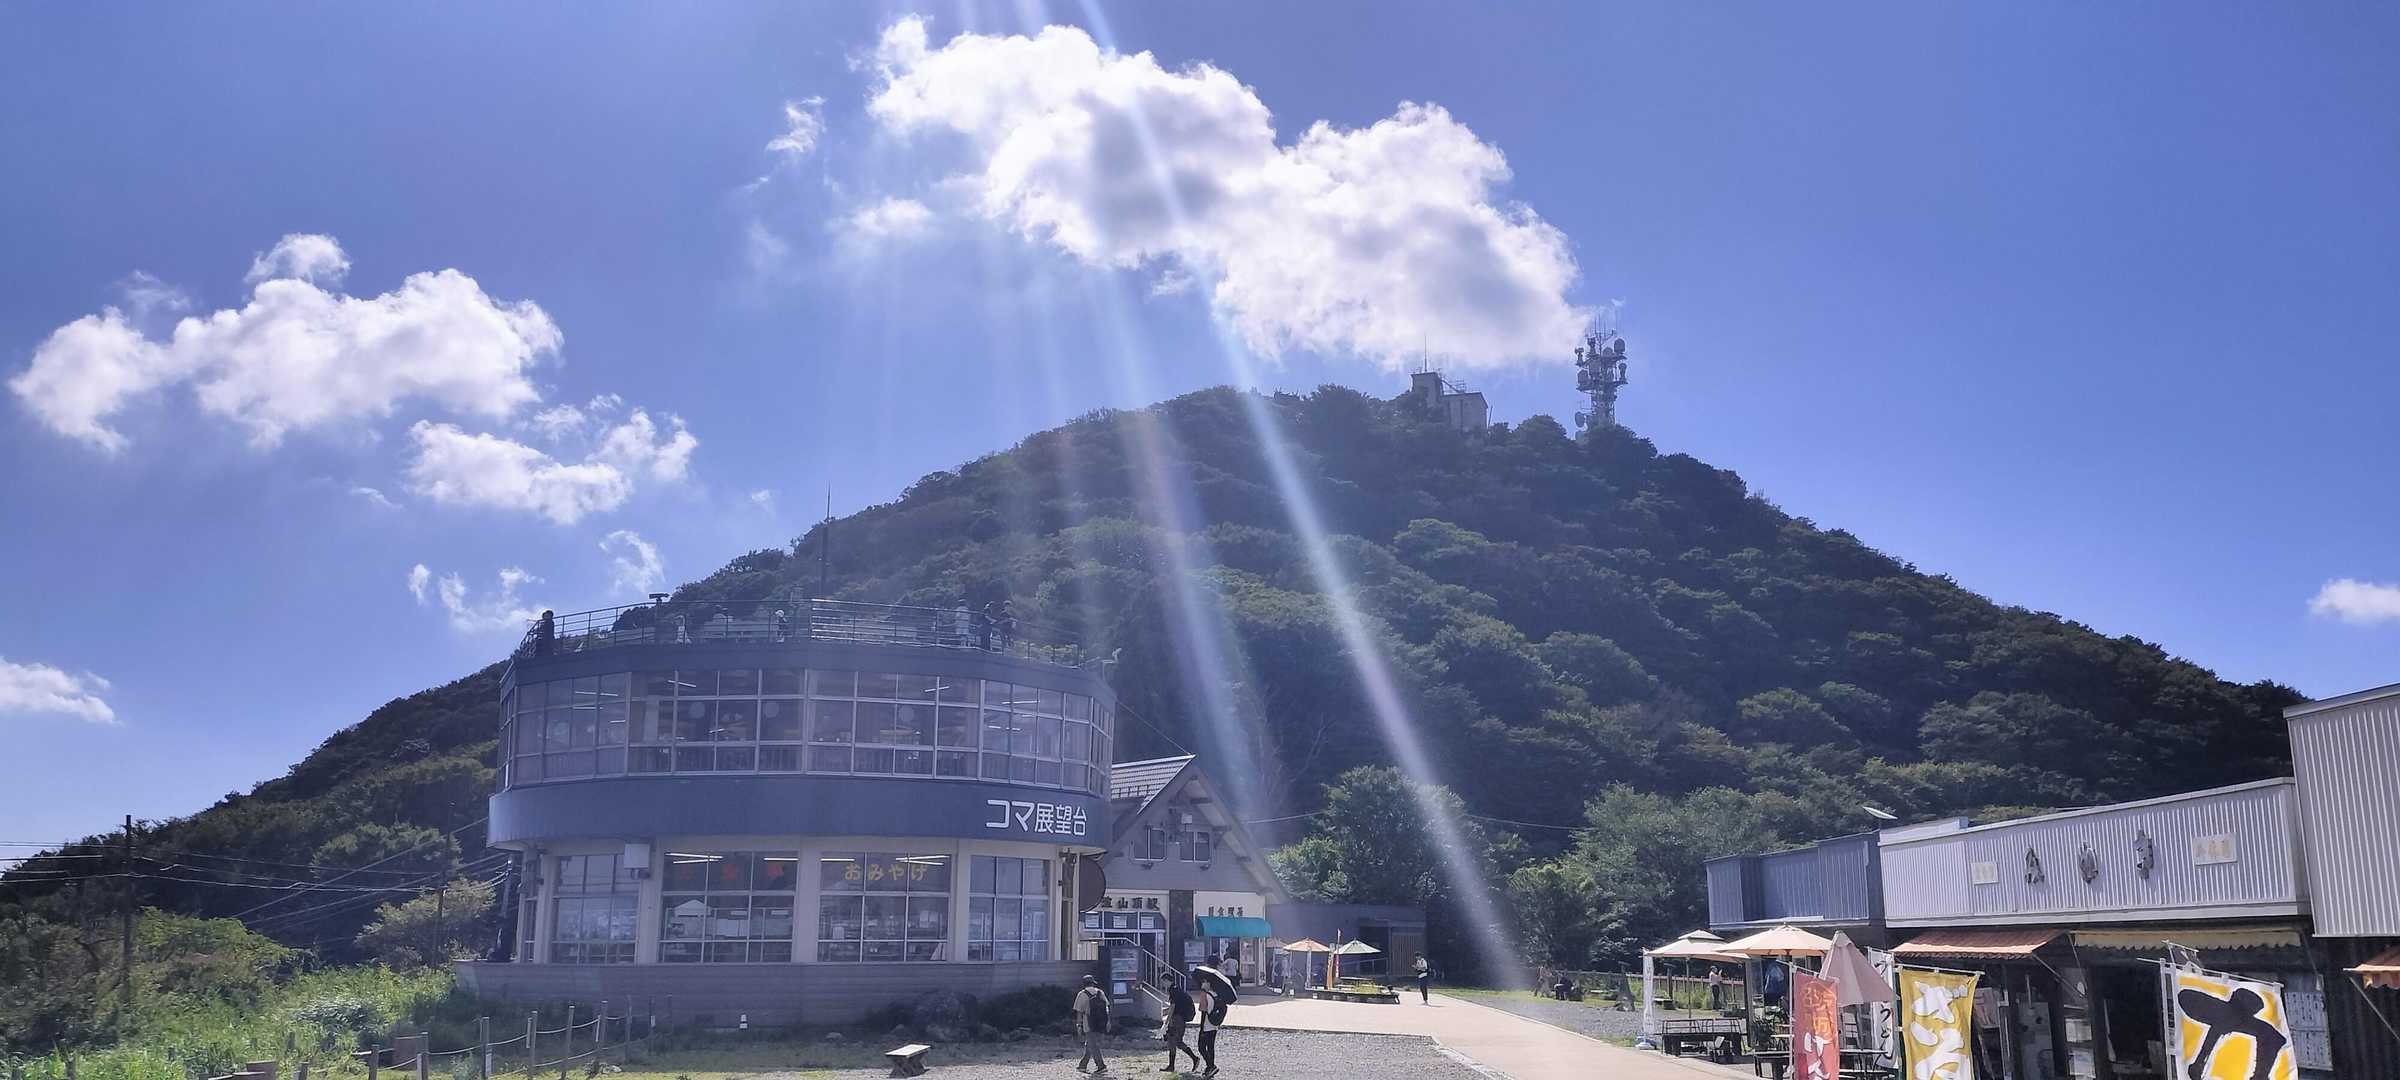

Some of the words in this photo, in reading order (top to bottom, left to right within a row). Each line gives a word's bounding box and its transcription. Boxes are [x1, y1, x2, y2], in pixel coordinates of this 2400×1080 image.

[985, 799, 1087, 836] コマ展望台
[844, 863, 928, 882] おみやげ
